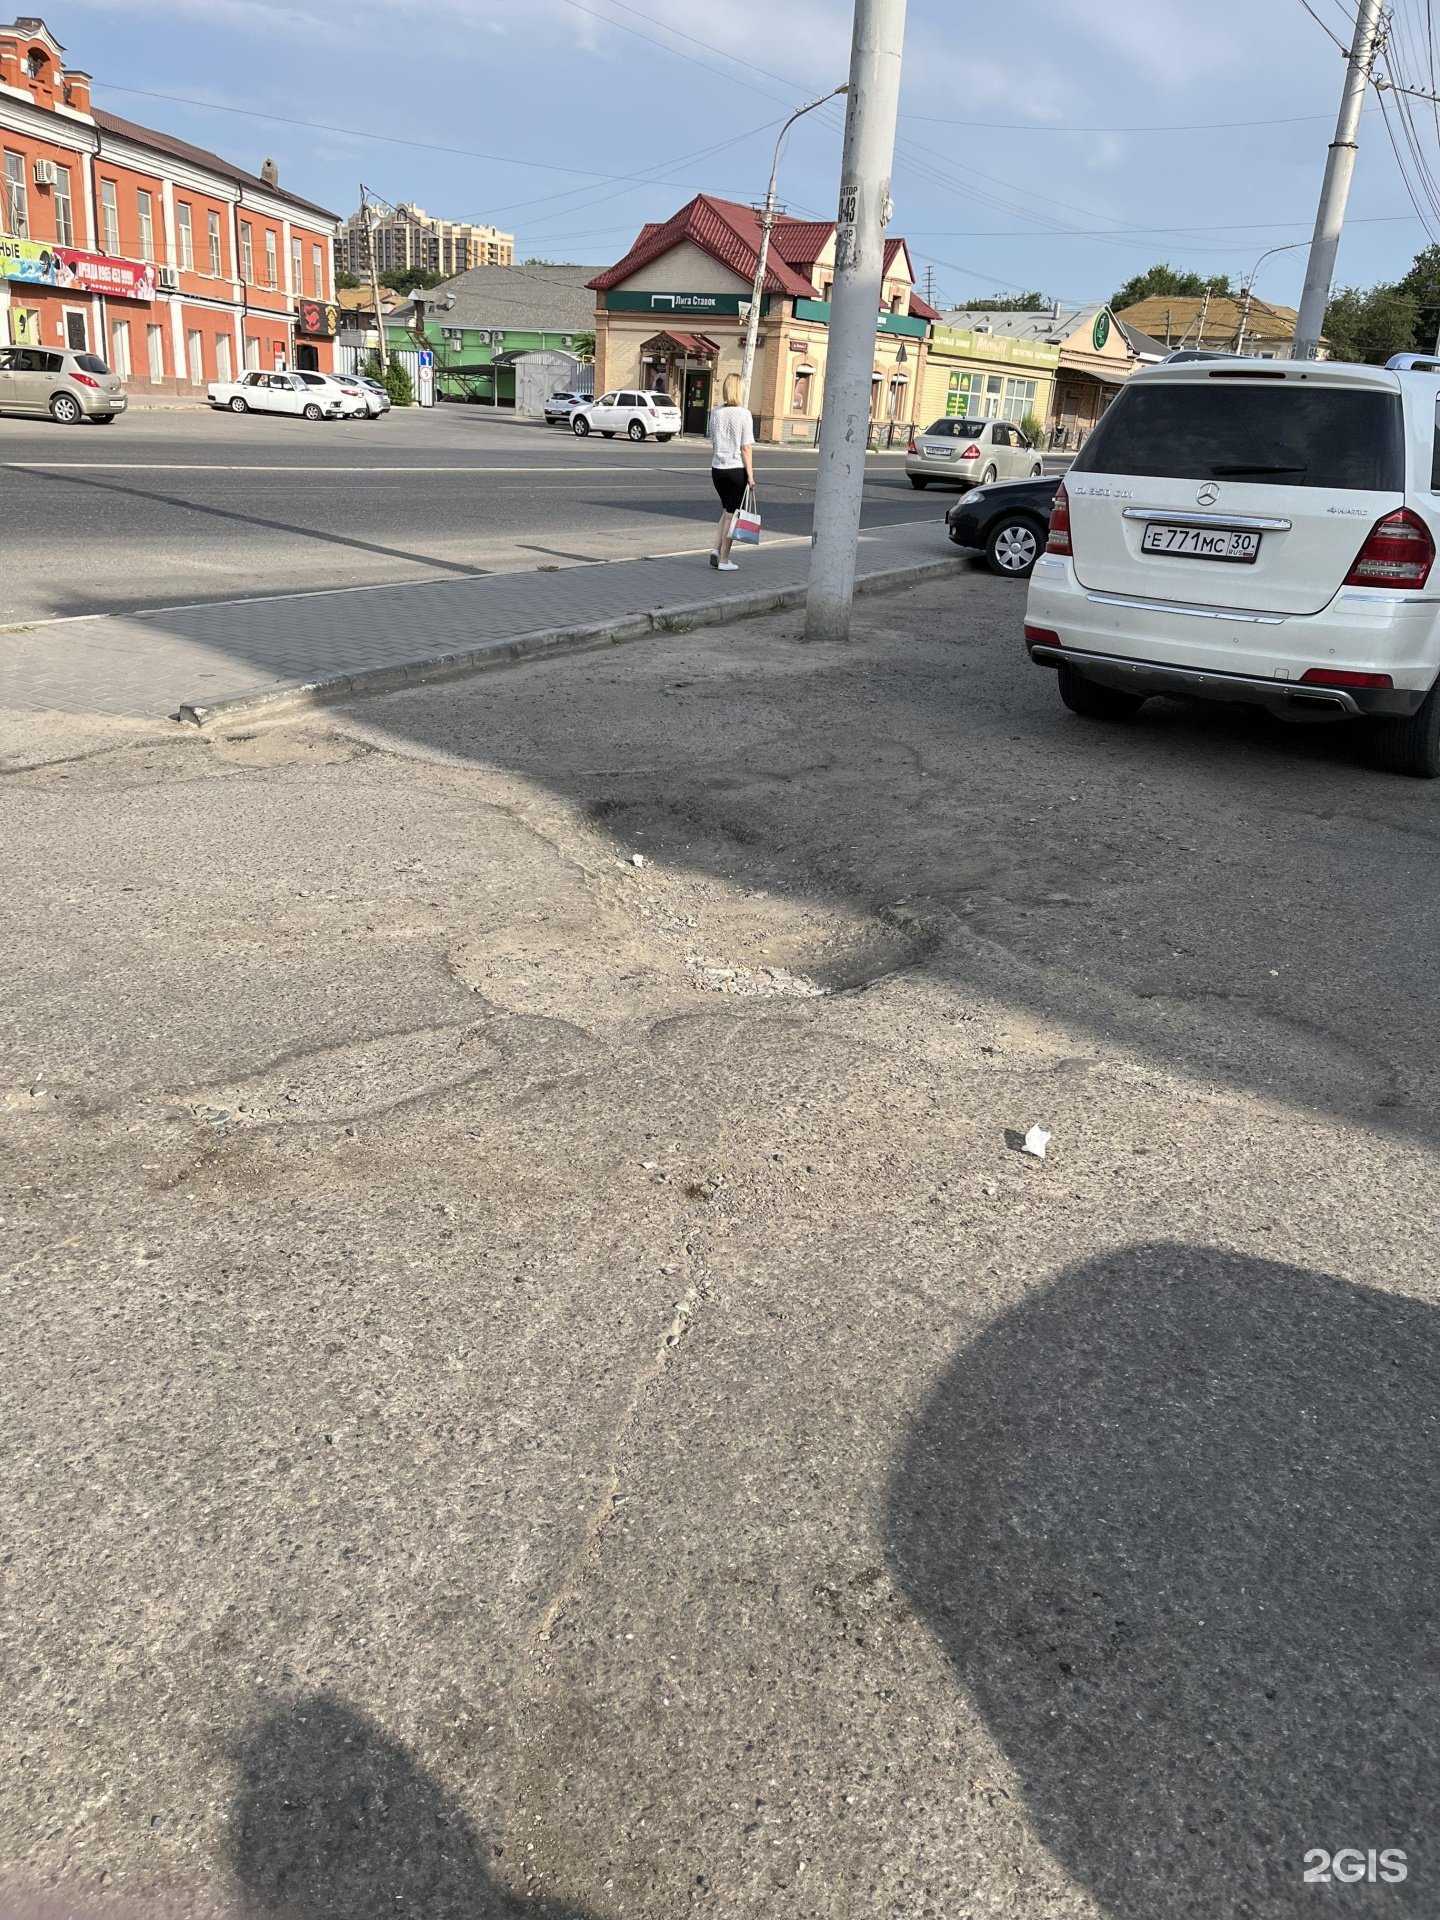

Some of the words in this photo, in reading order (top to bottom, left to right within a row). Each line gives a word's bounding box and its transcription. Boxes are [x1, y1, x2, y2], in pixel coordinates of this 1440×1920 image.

[676, 295, 692, 305] Лига
[692, 296, 716, 306] Ставок
[1231, 534, 1251, 550] 30
